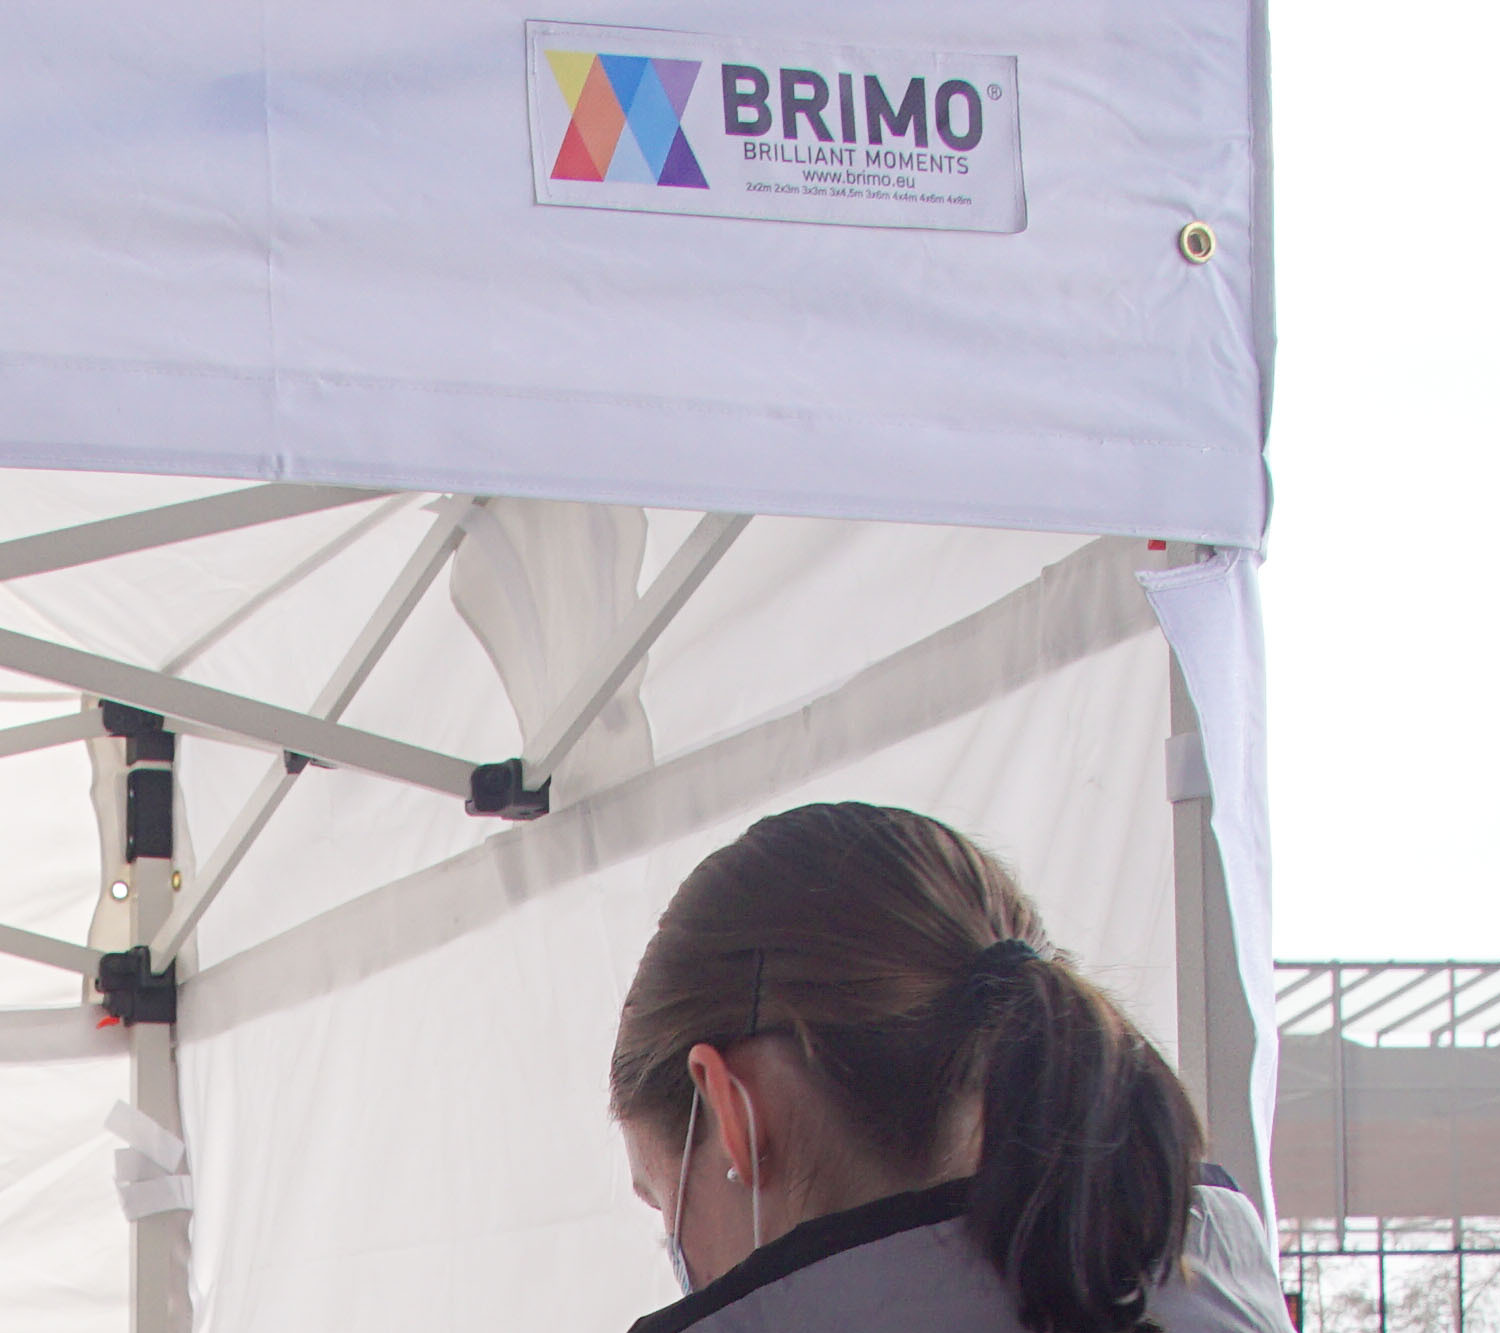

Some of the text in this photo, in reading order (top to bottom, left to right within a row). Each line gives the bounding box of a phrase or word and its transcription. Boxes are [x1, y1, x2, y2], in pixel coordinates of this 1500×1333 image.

[744, 142, 969, 175] BRILLIANT MOMENTS
[803, 169, 916, 189] www.brimo.eu
